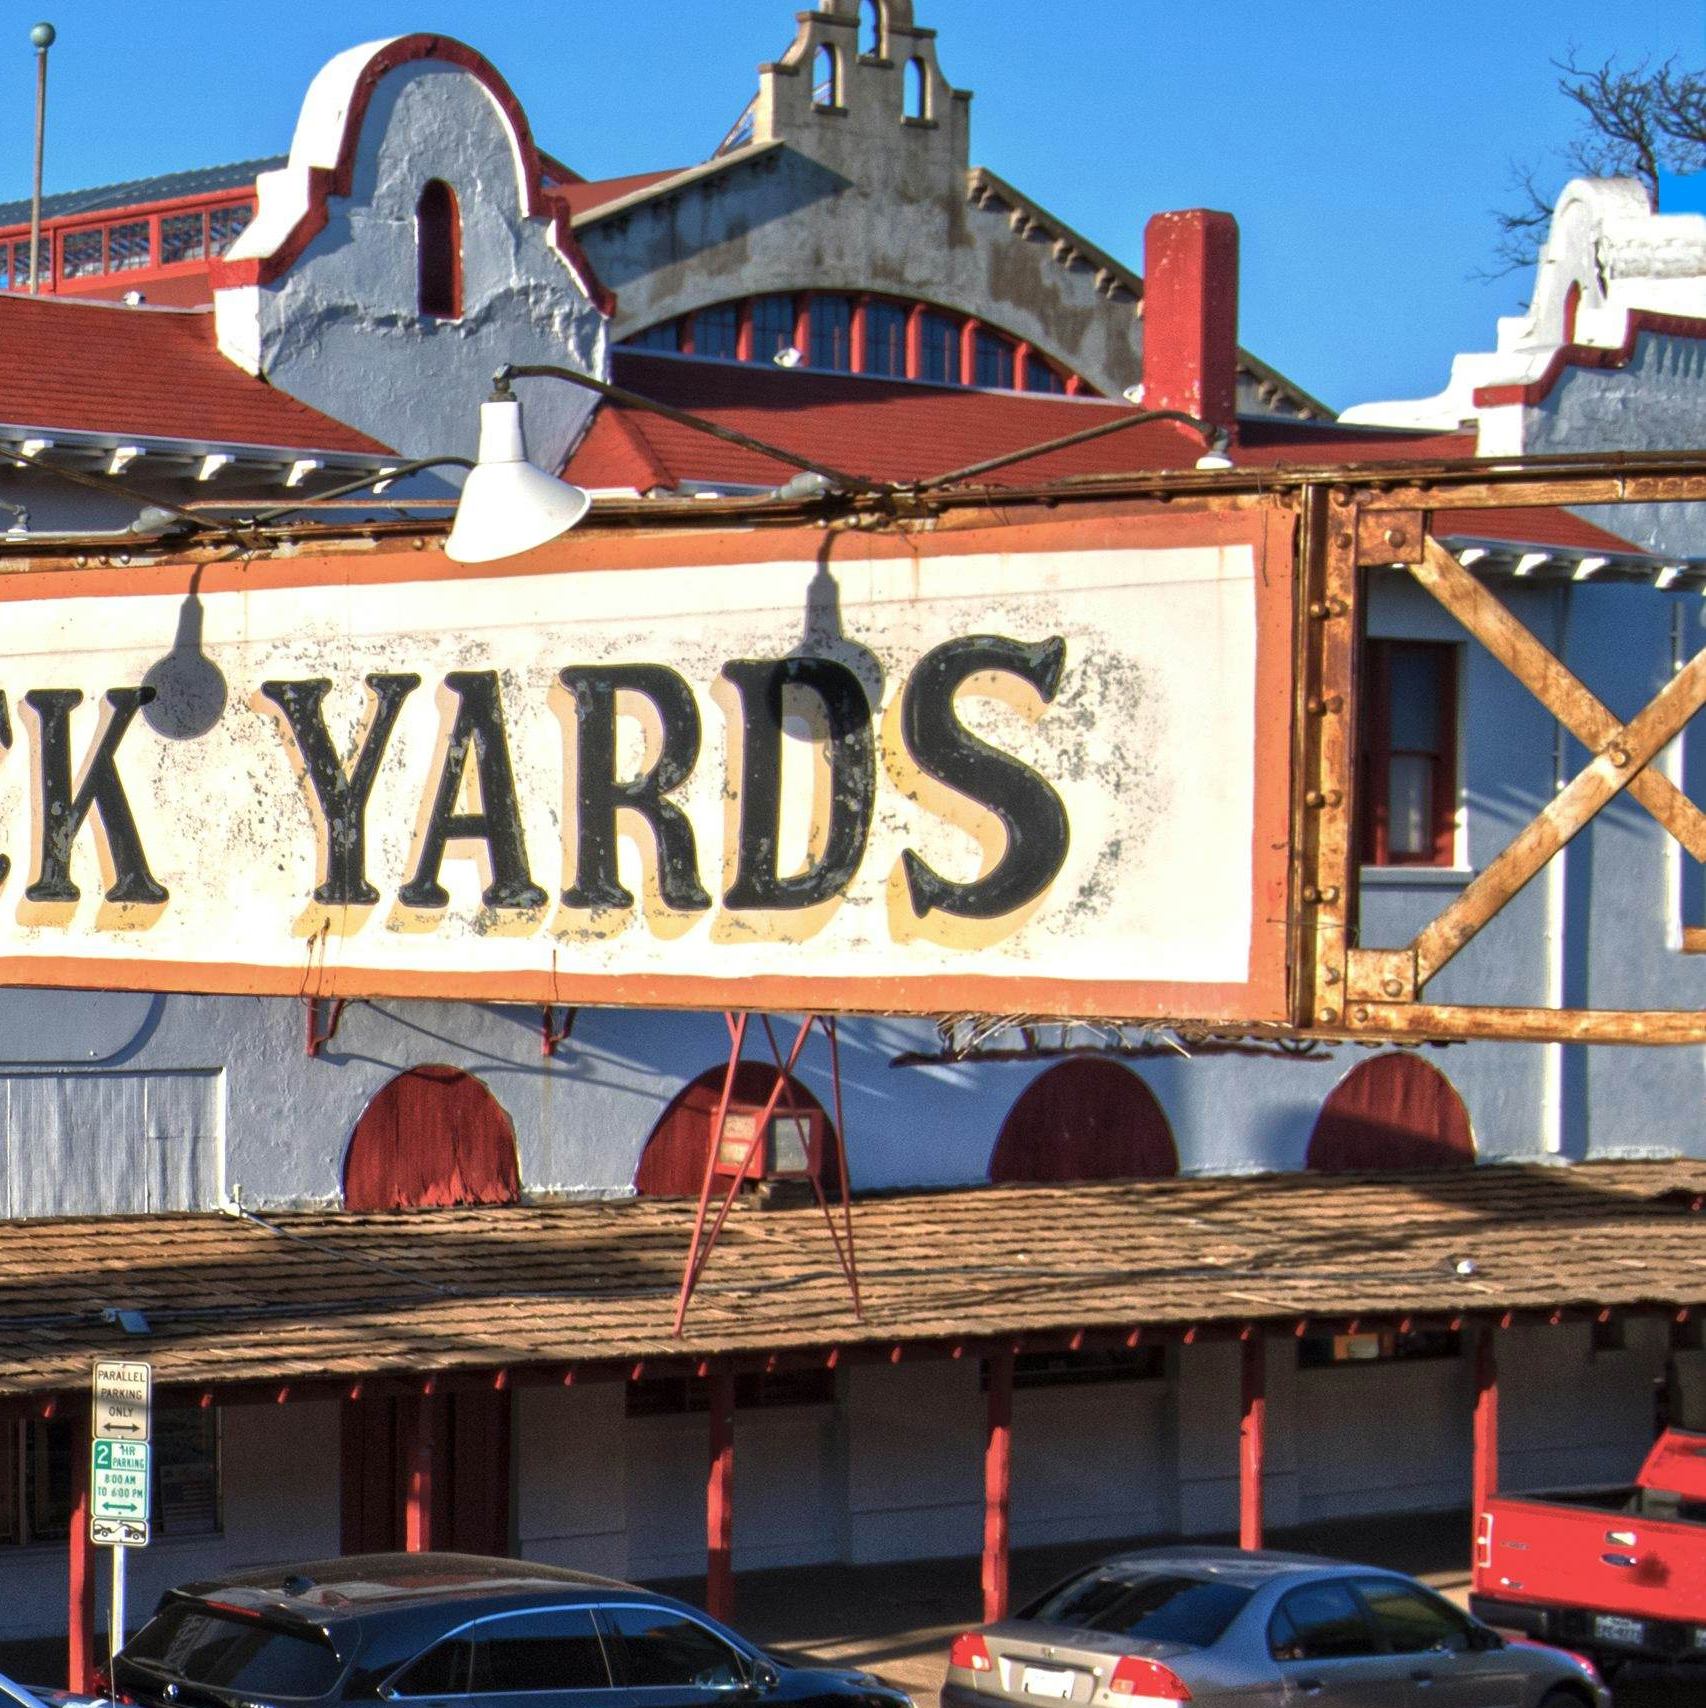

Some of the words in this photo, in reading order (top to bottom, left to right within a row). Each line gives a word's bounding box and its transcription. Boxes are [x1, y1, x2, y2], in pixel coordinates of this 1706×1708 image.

[262, 634, 1070, 918] YARDS
[98, 1370, 145, 1382] PARALLEL
[101, 1388, 143, 1400] PARKING
[109, 1406, 133, 1417] ONLY
[97, 1445, 108, 1464] 2
[121, 1446, 135, 1456] HR
[113, 1457, 144, 1469] PARKING
[124, 1475, 136, 1485] AM
[98, 1486, 107, 1497] TO
[132, 1489, 143, 1498] PM
